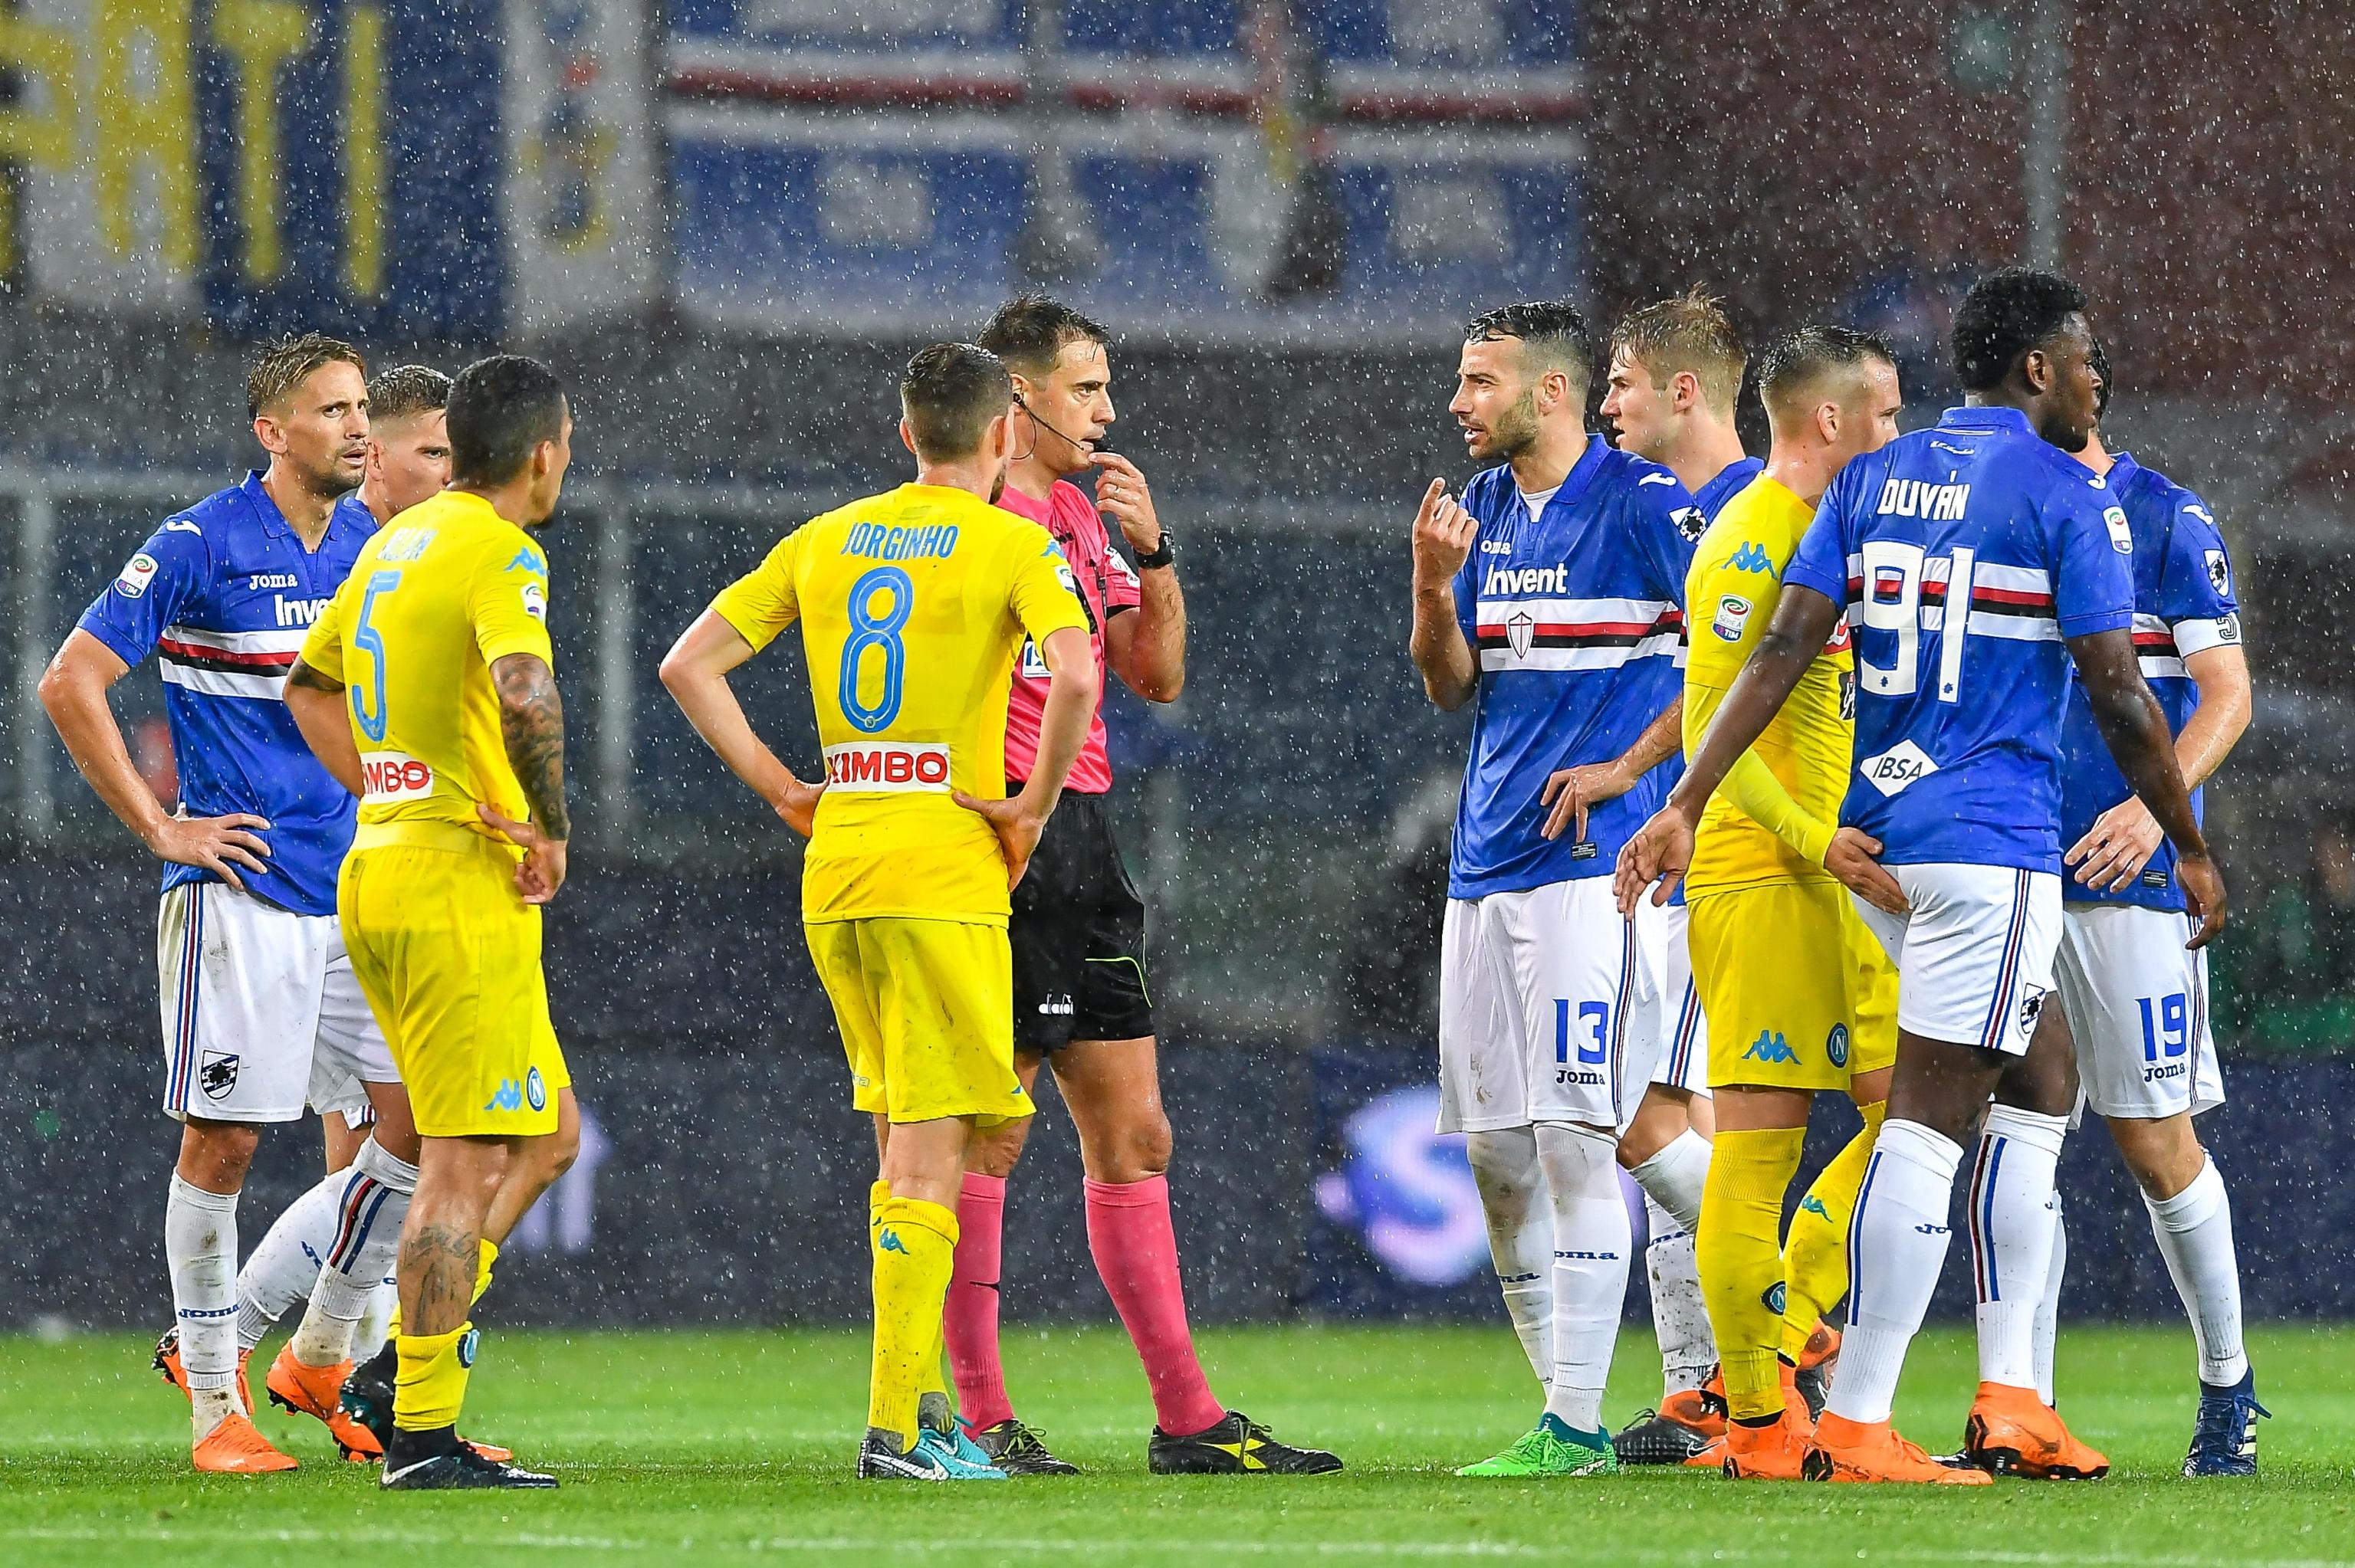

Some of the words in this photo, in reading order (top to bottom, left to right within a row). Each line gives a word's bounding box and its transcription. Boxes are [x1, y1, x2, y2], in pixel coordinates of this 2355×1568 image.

[1877, 470, 1971, 520] DUVÁN
[840, 523, 959, 560] JORGINHO
[1480, 540, 1512, 555] oma
[1483, 563, 1568, 595] Invent
[274, 594, 328, 626] Inve
[1861, 540, 1976, 704] 91
[351, 569, 402, 742] 5
[839, 566, 914, 733] 8
[1872, 757, 1923, 780] IBSA
[1552, 999, 1609, 1064] 13
[2134, 993, 2186, 1062] 19
[1554, 1251, 1619, 1260] oma
